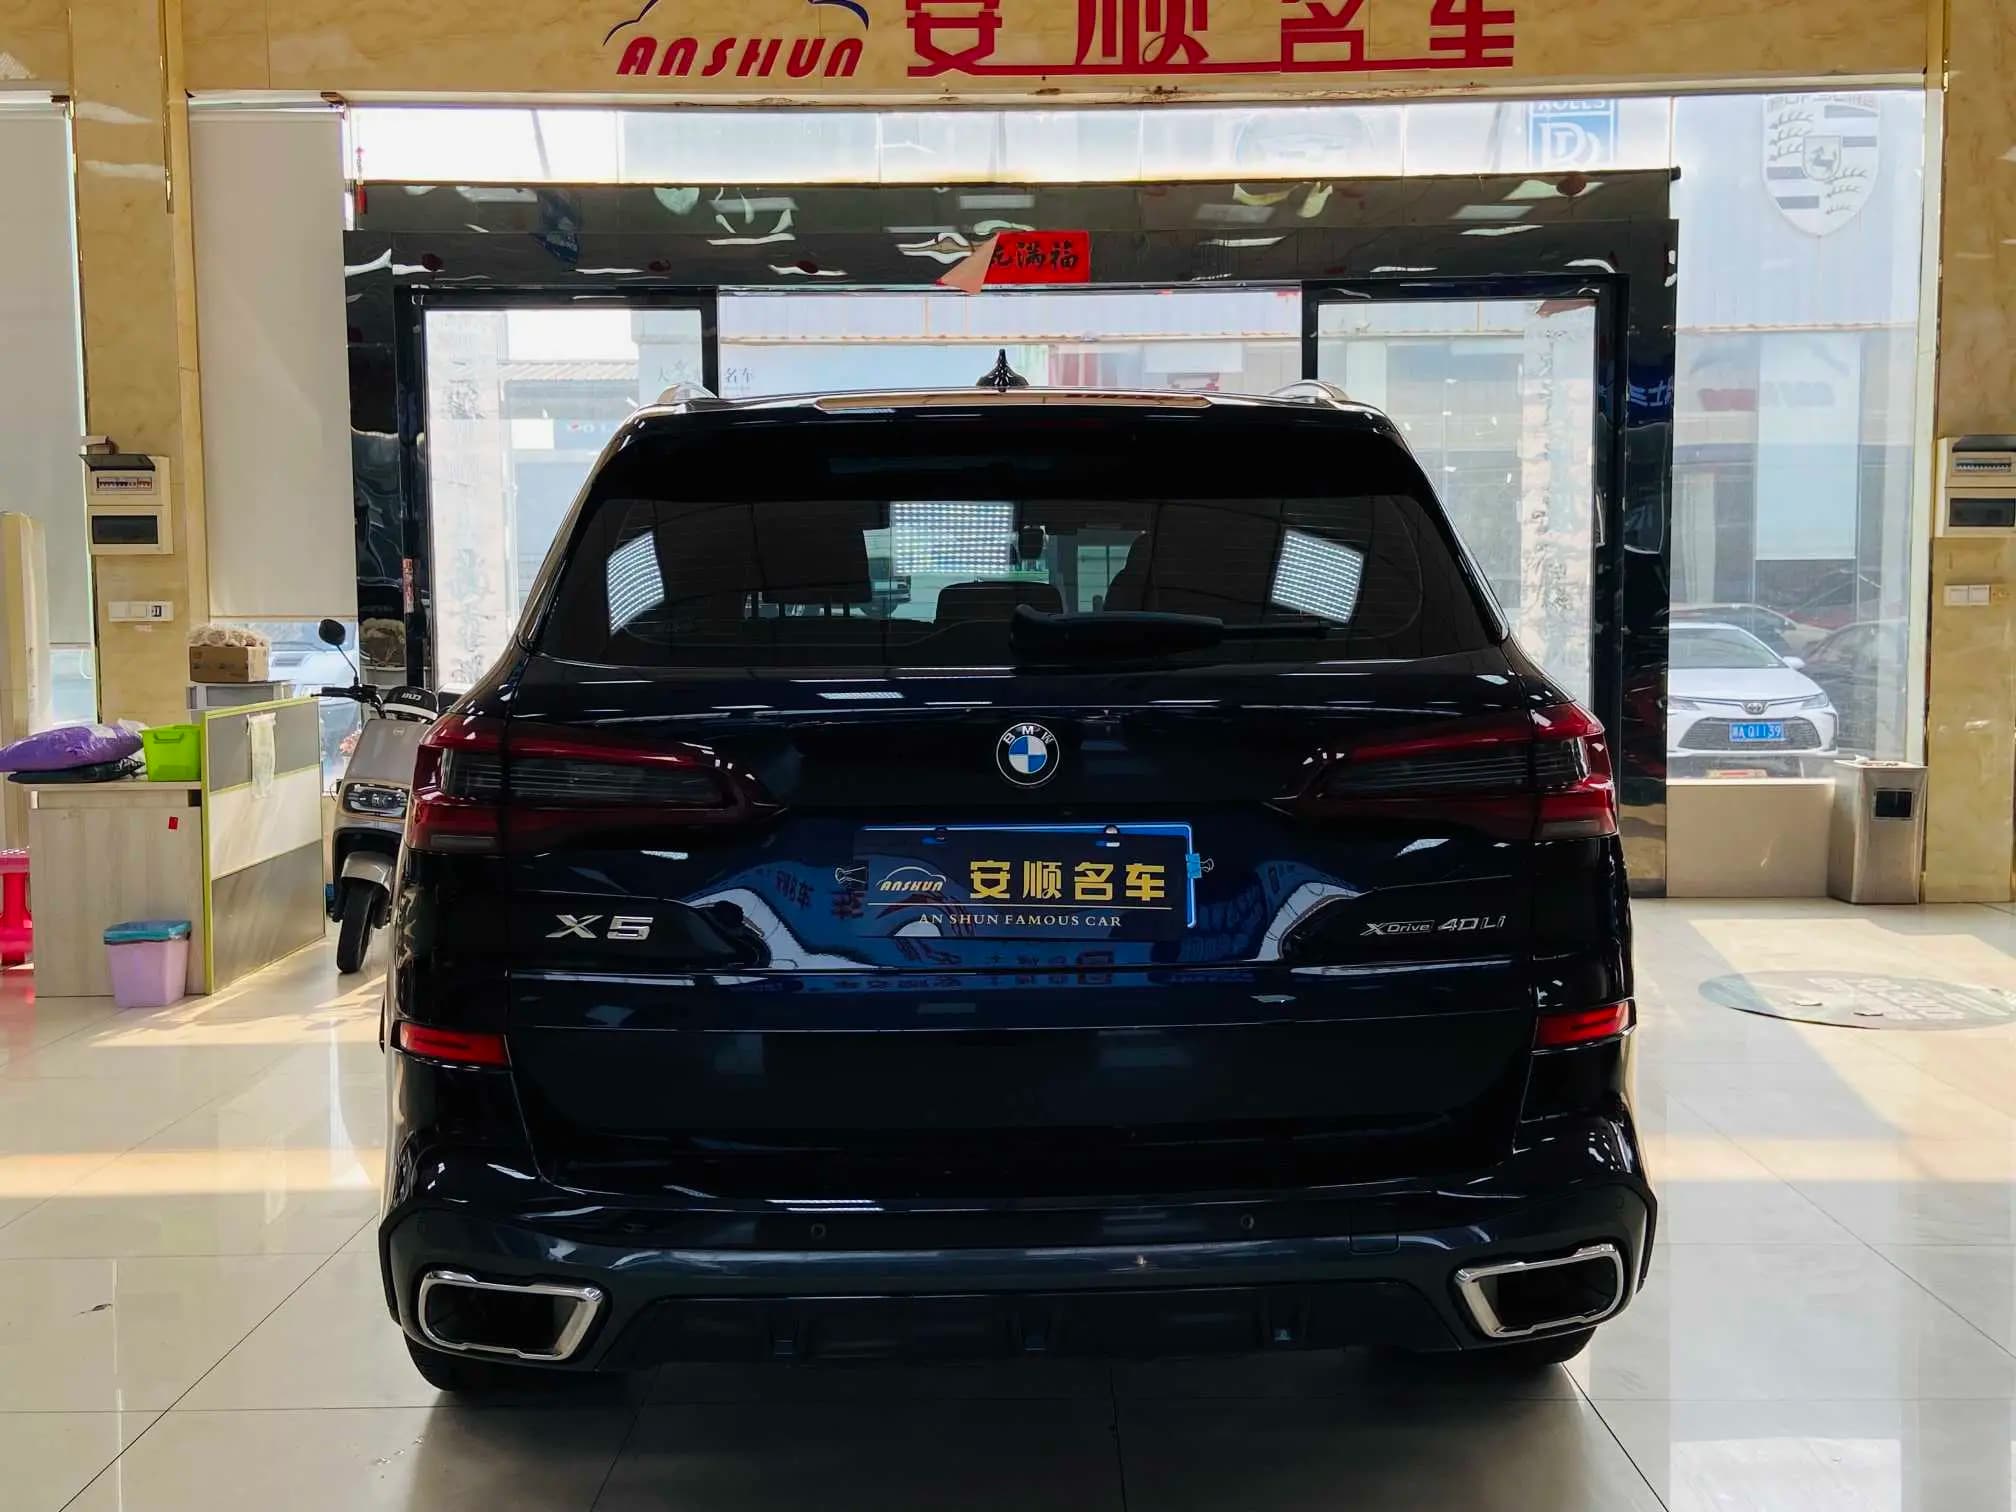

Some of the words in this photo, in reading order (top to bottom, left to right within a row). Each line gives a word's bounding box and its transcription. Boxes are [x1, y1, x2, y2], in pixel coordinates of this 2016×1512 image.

[907, 0, 1515, 76] 安顺名车
[616, 36, 862, 78] ANSHUN
[1003, 725, 1054, 746] BMW
[880, 880, 943, 893] ANSHUN
[969, 859, 1166, 902] 安顺名车
[544, 914, 655, 941] X5
[918, 912, 944, 926] AN
[948, 913, 999, 926] SHUN
[1004, 913, 1080, 927] FAMOUS
[1084, 915, 1122, 928] CAR
